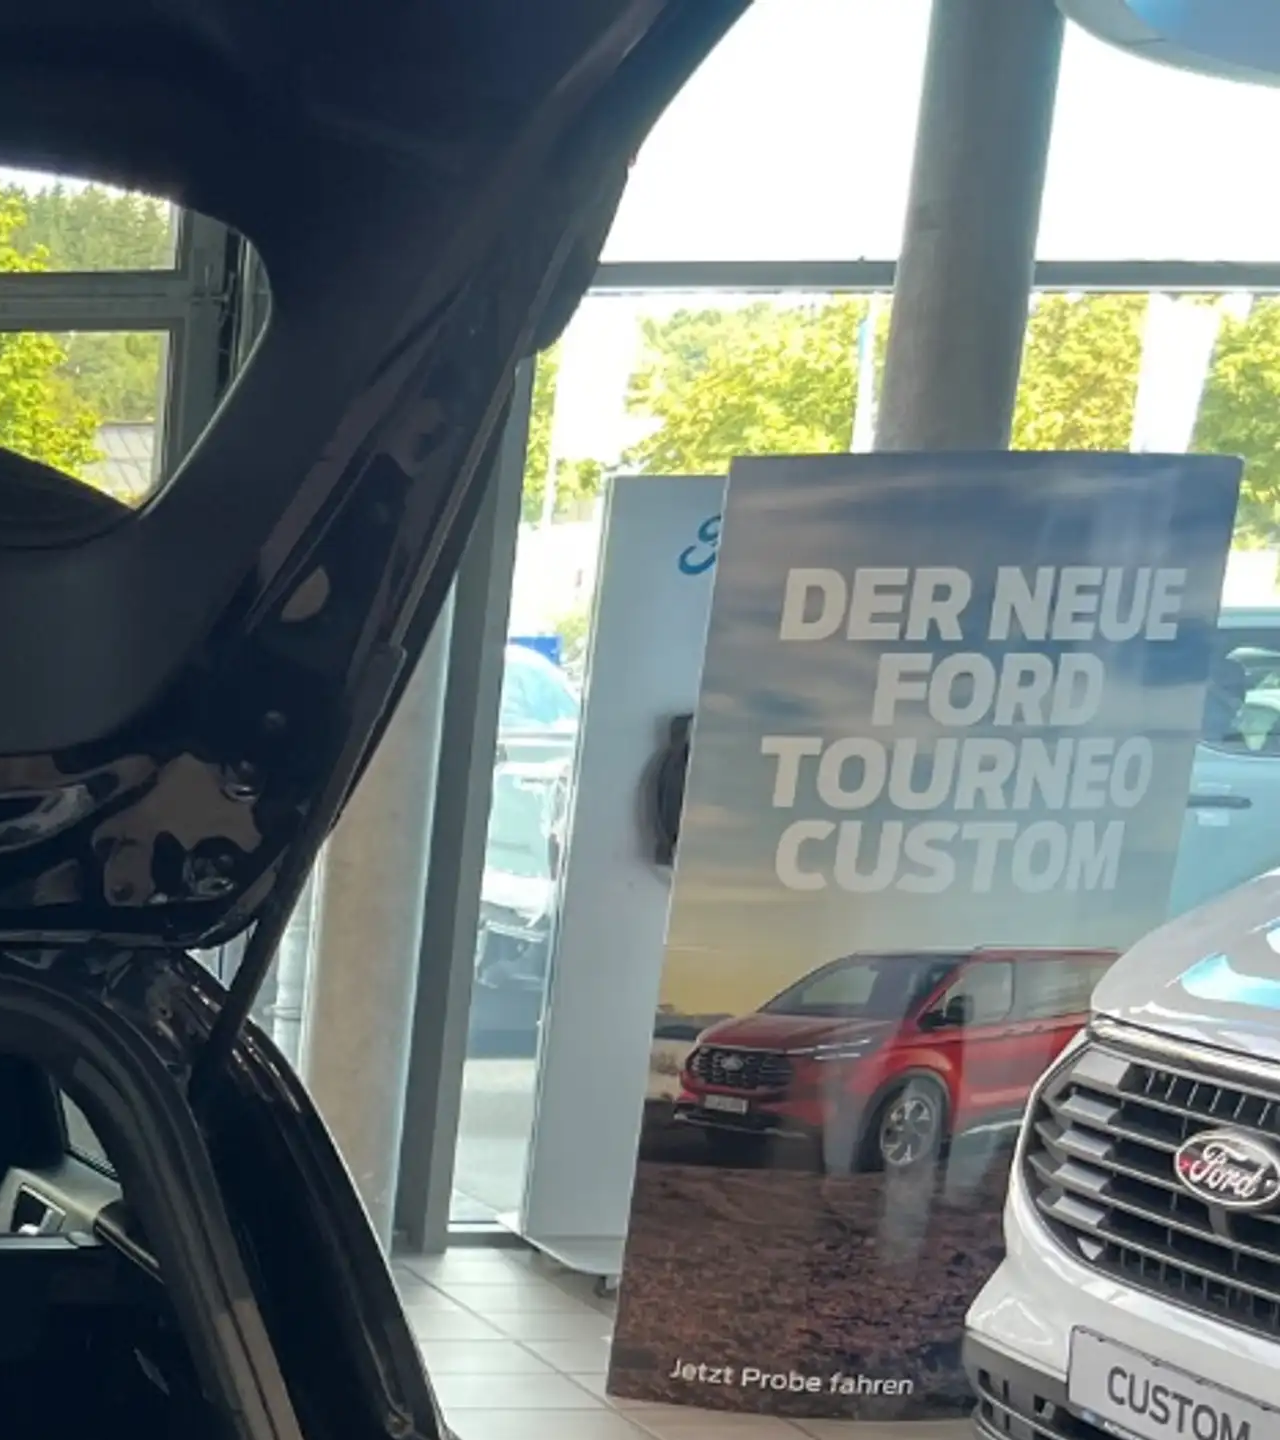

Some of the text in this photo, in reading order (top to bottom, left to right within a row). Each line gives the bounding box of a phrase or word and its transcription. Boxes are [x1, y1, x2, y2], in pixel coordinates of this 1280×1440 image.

[779, 566, 1188, 642] DER NEUE
[871, 652, 1105, 727] FORD
[761, 735, 1154, 811] TOURNEO
[775, 819, 1126, 894] CUSTOM
[1189, 1142, 1265, 1198] Ford
[670, 1357, 914, 1396] Jetzt Probe fahren
